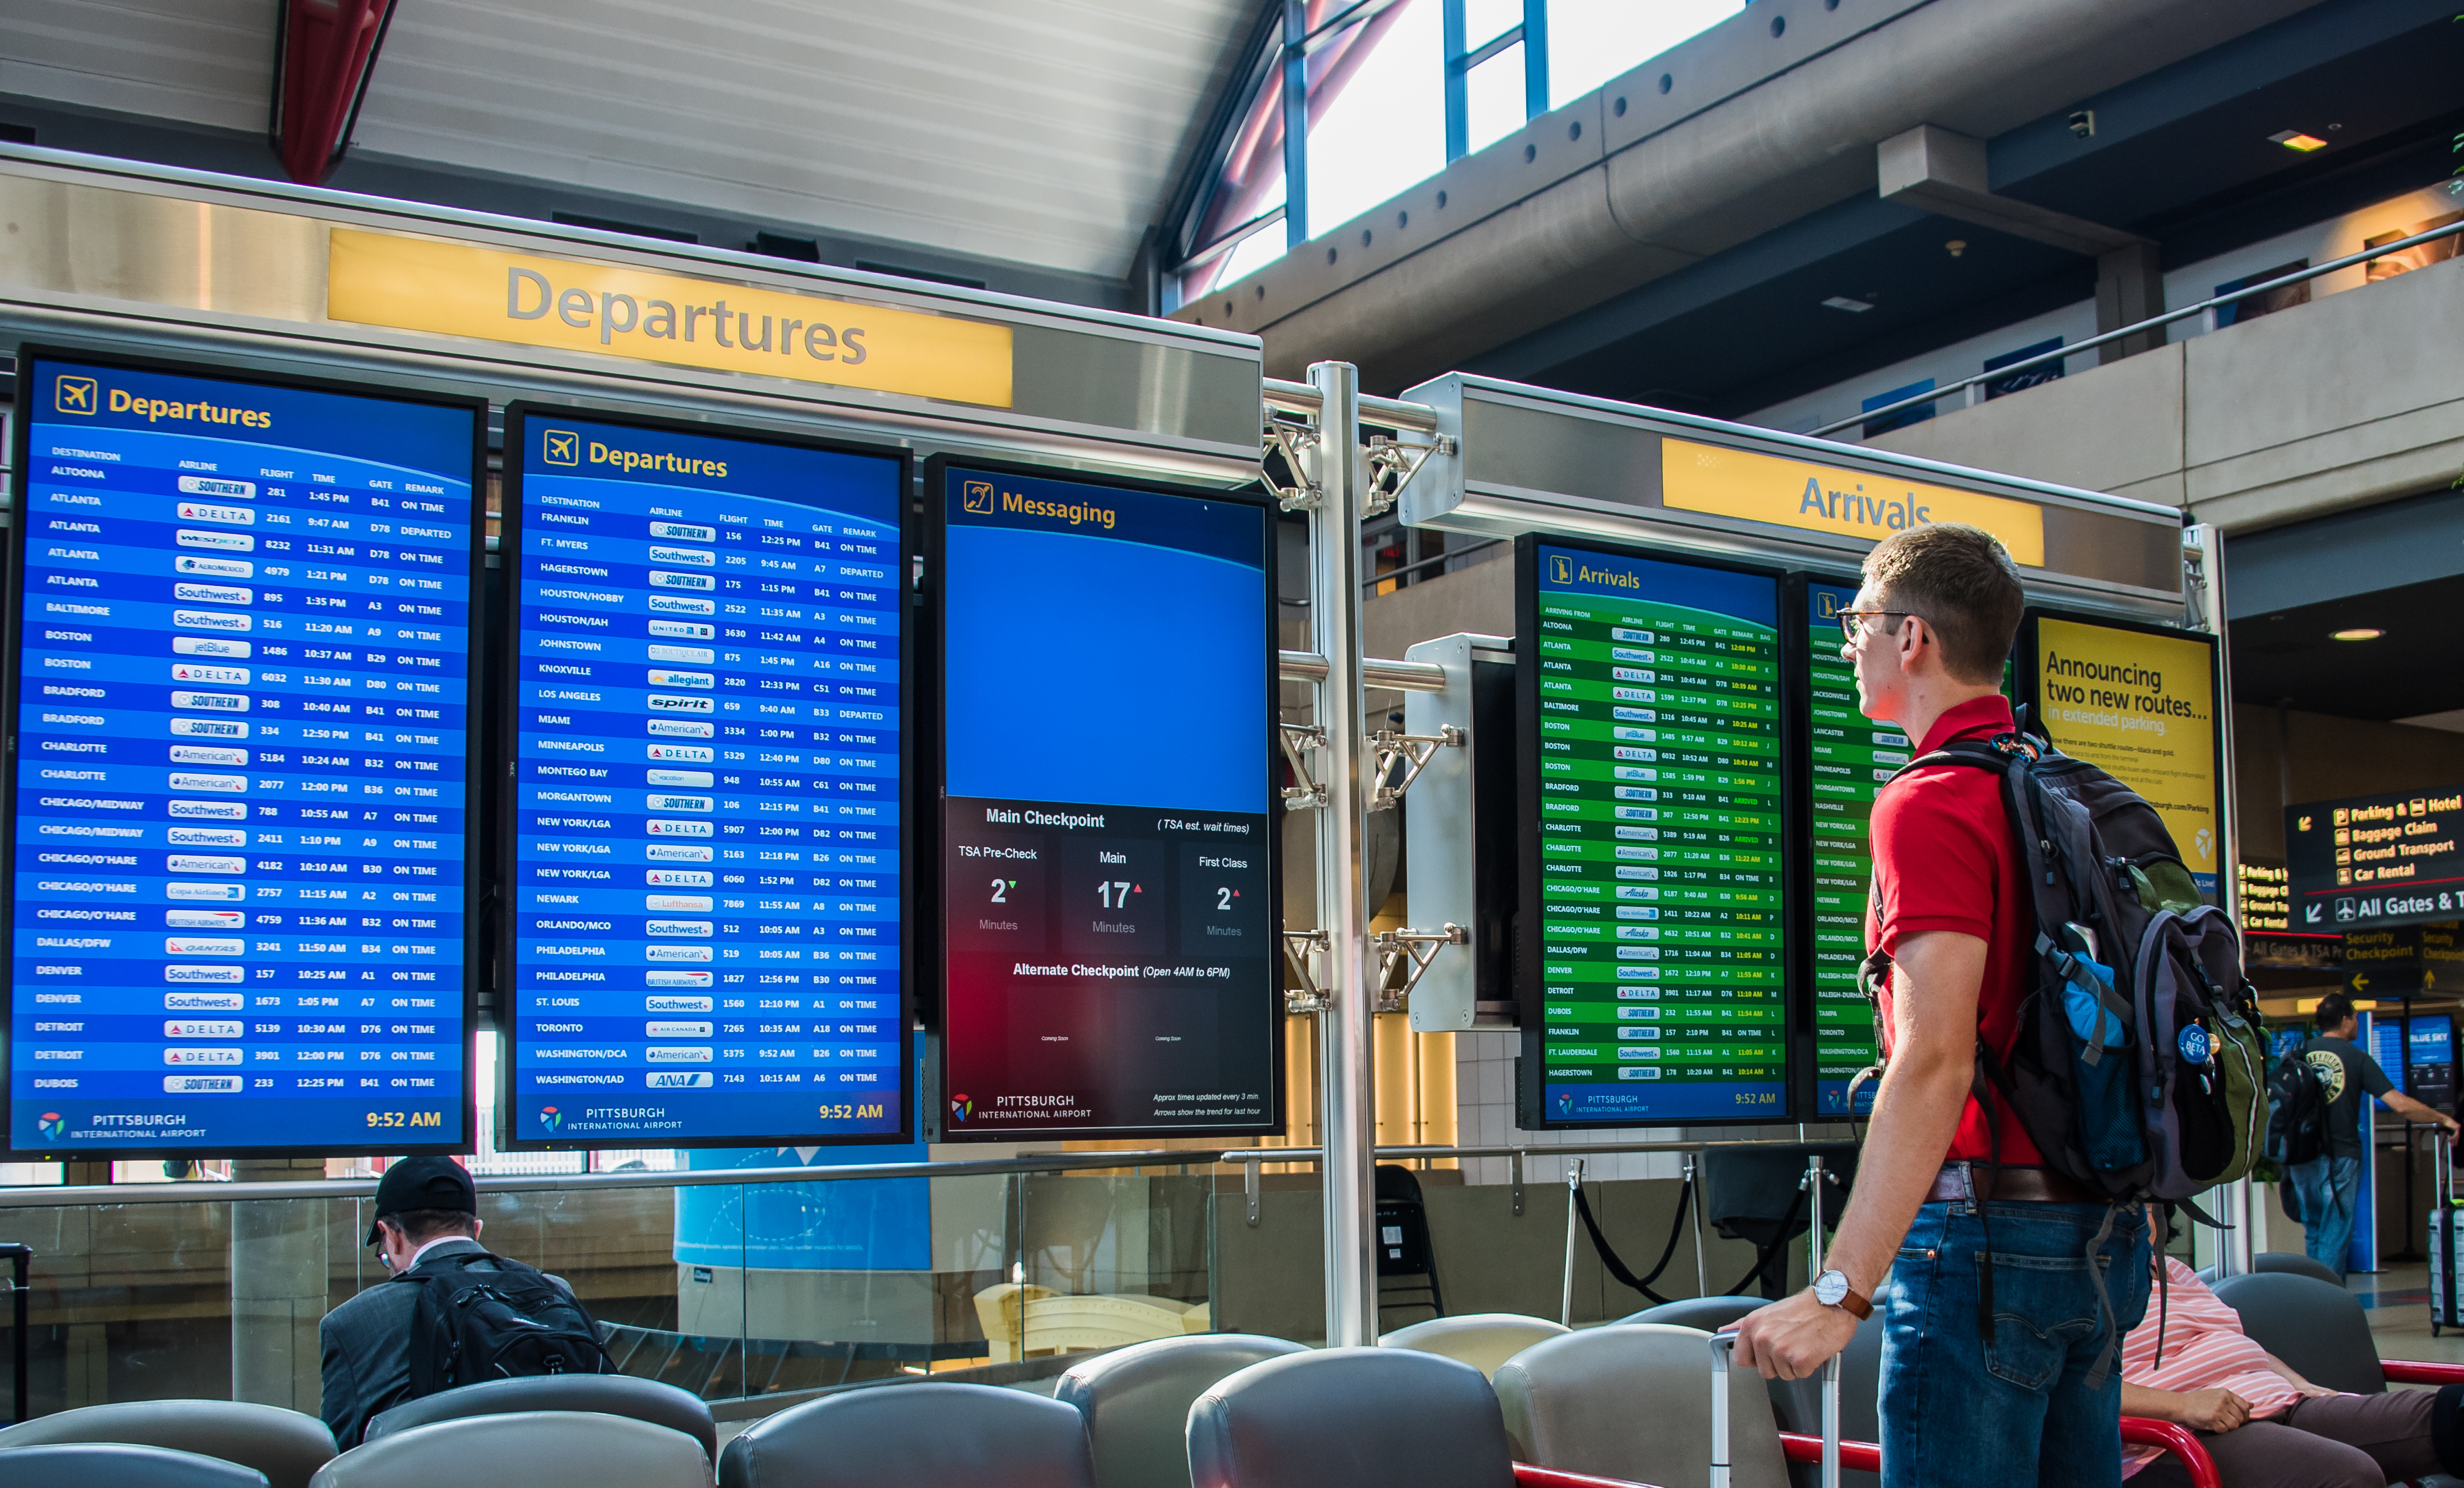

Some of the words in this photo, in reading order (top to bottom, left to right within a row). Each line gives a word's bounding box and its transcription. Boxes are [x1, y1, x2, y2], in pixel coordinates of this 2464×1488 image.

[507, 266, 867, 364] Departures
[108, 389, 272, 429] Departures
[589, 442, 728, 478] Departures
[51, 447, 121, 462] DESTINATION
[179, 460, 217, 471] AIRLINE
[260, 469, 294, 479] FLIGHT
[312, 474, 336, 483] TIME
[369, 480, 393, 489] GATE
[405, 483, 444, 495] REMARK
[51, 465, 106, 479] ALTOONA
[198, 481, 246, 495] SOUTHERN
[267, 488, 286, 497] 281
[309, 492, 330, 501] 1:45
[333, 494, 349, 503] PM
[371, 497, 390, 507] B41
[401, 501, 417, 510] ON
[420, 503, 445, 512] TIME
[1002, 492, 1116, 529] Messaging
[1799, 477, 1930, 530] Arrivals
[50, 493, 102, 506] ATLANTA
[199, 509, 247, 521] DELTA
[266, 514, 291, 524] 2161
[308, 518, 329, 527] 9:47
[331, 520, 349, 529] AM
[370, 524, 391, 533] D78
[401, 527, 452, 538] DEPARTED
[542, 495, 600, 509] DESTINATION
[650, 507, 682, 517] AIRLINE
[719, 514, 748, 524] FLIGHT
[764, 519, 784, 527] TIME
[812, 524, 833, 533] GATE
[843, 527, 876, 537] REMARK
[1579, 565, 1640, 589] Arrivals
[1545, 607, 1573, 616] ARRIVING
[1621, 616, 1643, 625] AIRLINE
[1543, 661, 1571, 671] ATLANTA
[1624, 671, 1651, 680] DELTA
[2046, 651, 2161, 694] Announcing
[539, 664, 591, 676] KNOXVILLE
[667, 675, 709, 686] allegiant
[724, 677, 745, 686] 2820
[760, 680, 784, 689] 12:33
[785, 682, 800, 691] PM
[813, 685, 829, 693] C51
[839, 686, 854, 694] ON
[855, 687, 876, 696] TIME
[1813, 691, 1850, 701] JACKSONVILLE
[2047, 679, 2085, 704] two
[2090, 688, 2130, 709] new
[2135, 694, 2207, 720] routes...
[1813, 709, 1847, 718] JOHNSTOWN
[2048, 703, 2060, 719] in
[2062, 708, 2118, 727] extended
[2121, 714, 2167, 737] parking.
[1813, 728, 1844, 737] LANCASTER
[1814, 746, 1832, 754] MIAMI
[2351, 806, 2394, 822] Parking
[2396, 802, 2407, 816] &
[2429, 795, 2462, 812] Hotel
[987, 808, 1020, 823] Main
[1025, 811, 1104, 829] Checkpoint
[1185, 821, 1201, 831] est.
[1204, 822, 1221, 832] wait
[1223, 823, 1249, 835] times)
[2352, 827, 2401, 843] Baggage
[2405, 821, 2437, 836] Claim
[958, 846, 981, 857] TSA
[983, 847, 1037, 859] Pre-Check
[2353, 844, 2396, 861] Ground
[2398, 839, 2455, 856] Transport
[1100, 851, 1126, 864] Main
[1199, 857, 1220, 868] First
[1222, 858, 1247, 868] Class
[2354, 869, 2374, 882] Car
[2377, 863, 2415, 879] Rental
[991, 879, 1006, 903] 2
[1098, 881, 1130, 909] 17
[1217, 887, 1231, 910] 2
[2358, 898, 2382, 917] All
[2385, 896, 2434, 915] Gates
[2438, 893, 2452, 910] &
[979, 919, 1018, 930] Minutes
[1093, 921, 1135, 934] Minutes
[2250, 916, 2263, 927] Car
[2264, 917, 2288, 929] Rental
[1207, 925, 1242, 936] Minutes
[2346, 931, 2394, 945] Security
[2346, 945, 2413, 961] Checkpoint
[1013, 963, 1068, 976] Alternate
[1071, 964, 1139, 979] Checkpoint
[1143, 966, 1171, 978] (Open
[1173, 967, 1194, 977] 4AM
[1196, 967, 1205, 977] to
[1207, 967, 1230, 979] 6PM)
[2191, 1033, 2204, 1043] GO
[2409, 1033, 2430, 1043] BLUE
[2186, 1041, 2205, 1055] BETA
[997, 1096, 1074, 1106] PITTSBURGH
[1153, 1094, 1176, 1102] Approx
[1196, 1093, 1222, 1102] updated
[1588, 1095, 1638, 1103] PITTSBURGH
[1735, 1093, 1756, 1104] 9:52
[1758, 1093, 1776, 1103] AM
[587, 1108, 665, 1118] PITTSBURGH
[819, 1105, 852, 1118] 9:52
[857, 1105, 883, 1118] AM
[979, 1111, 1050, 1119] INTERNATIONAL
[92, 1114, 186, 1126] PITTSBURGH
[366, 1112, 404, 1127] 9:52
[409, 1112, 441, 1127] AM
[70, 1130, 157, 1138] INTERNATIONAL
[160, 1129, 206, 1138] AIRPORT
